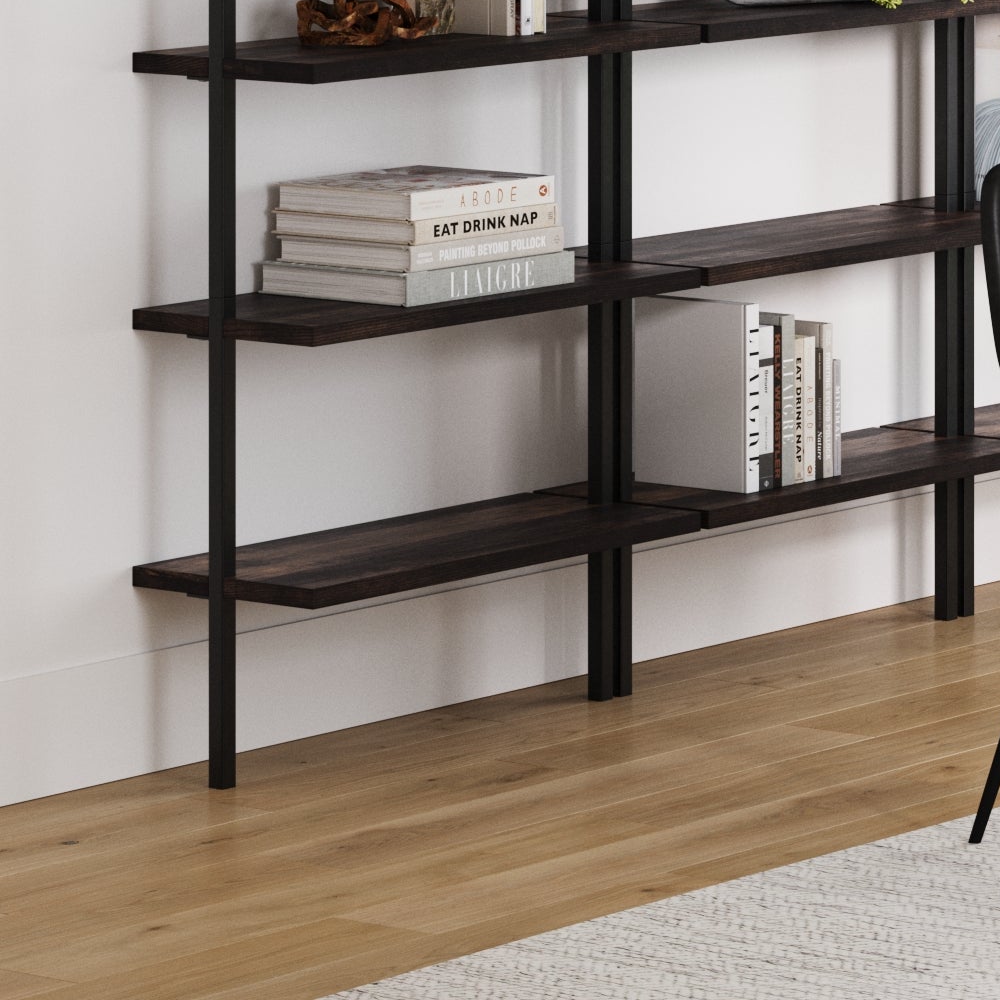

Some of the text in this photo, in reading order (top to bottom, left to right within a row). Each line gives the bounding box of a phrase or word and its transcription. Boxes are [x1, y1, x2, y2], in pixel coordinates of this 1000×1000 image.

[459, 186, 518, 208] ABODE
[433, 222, 459, 237] EAT
[463, 215, 505, 233] DRINK
[510, 211, 538, 227] NAP
[439, 246, 476, 261] PAINTING
[478, 241, 508, 256] BEYOND
[511, 235, 546, 252] POLLOCK
[450, 260, 535, 298] LIAIGRE
[782, 358, 795, 445] LIAIGRE
[774, 386, 782, 478] WEARSTLER
